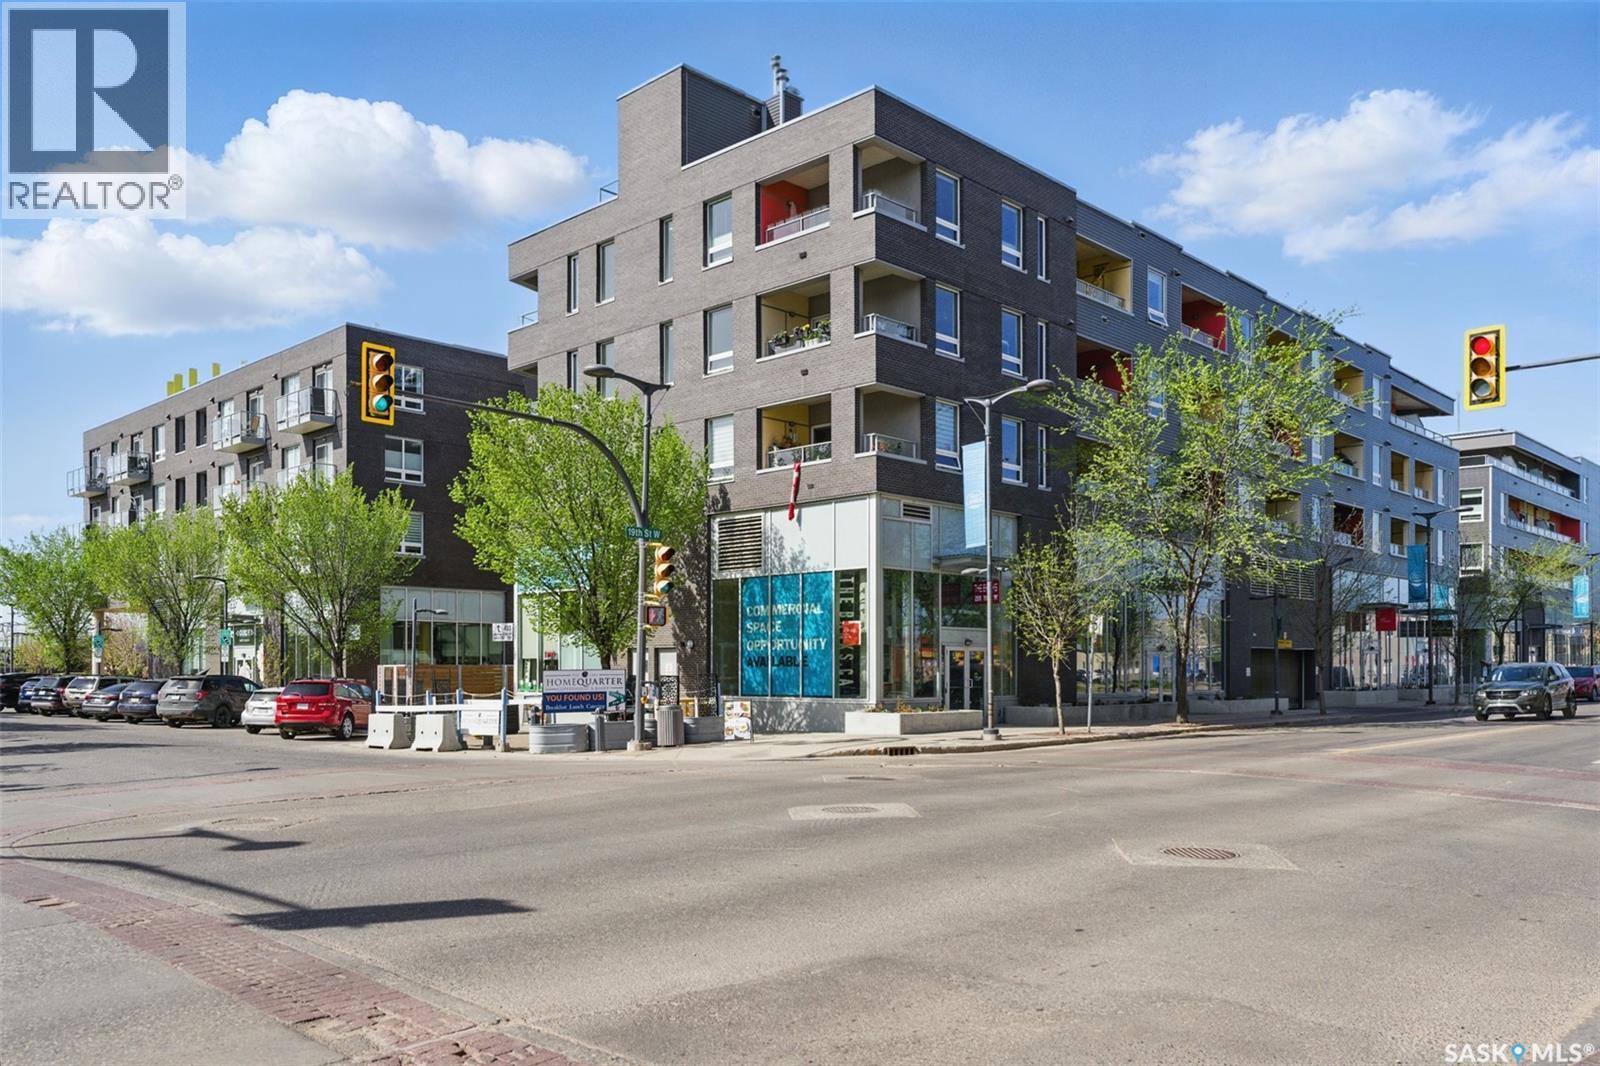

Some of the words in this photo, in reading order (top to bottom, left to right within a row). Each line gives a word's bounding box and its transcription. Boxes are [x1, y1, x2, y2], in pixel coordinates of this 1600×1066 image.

[628, 528, 644, 537] 19th
[653, 530, 661, 538] W
[746, 603, 824, 617] COMMERCIAL
[746, 620, 782, 634] SPACE
[746, 638, 827, 652] OPPORTUNITY
[839, 611, 854, 687] BKS.CA
[746, 655, 809, 669] AVAILABLE
[546, 677, 623, 687] HOMEQUARTER
[545, 694, 563, 702] YOU
[564, 694, 592, 702] FOUND
